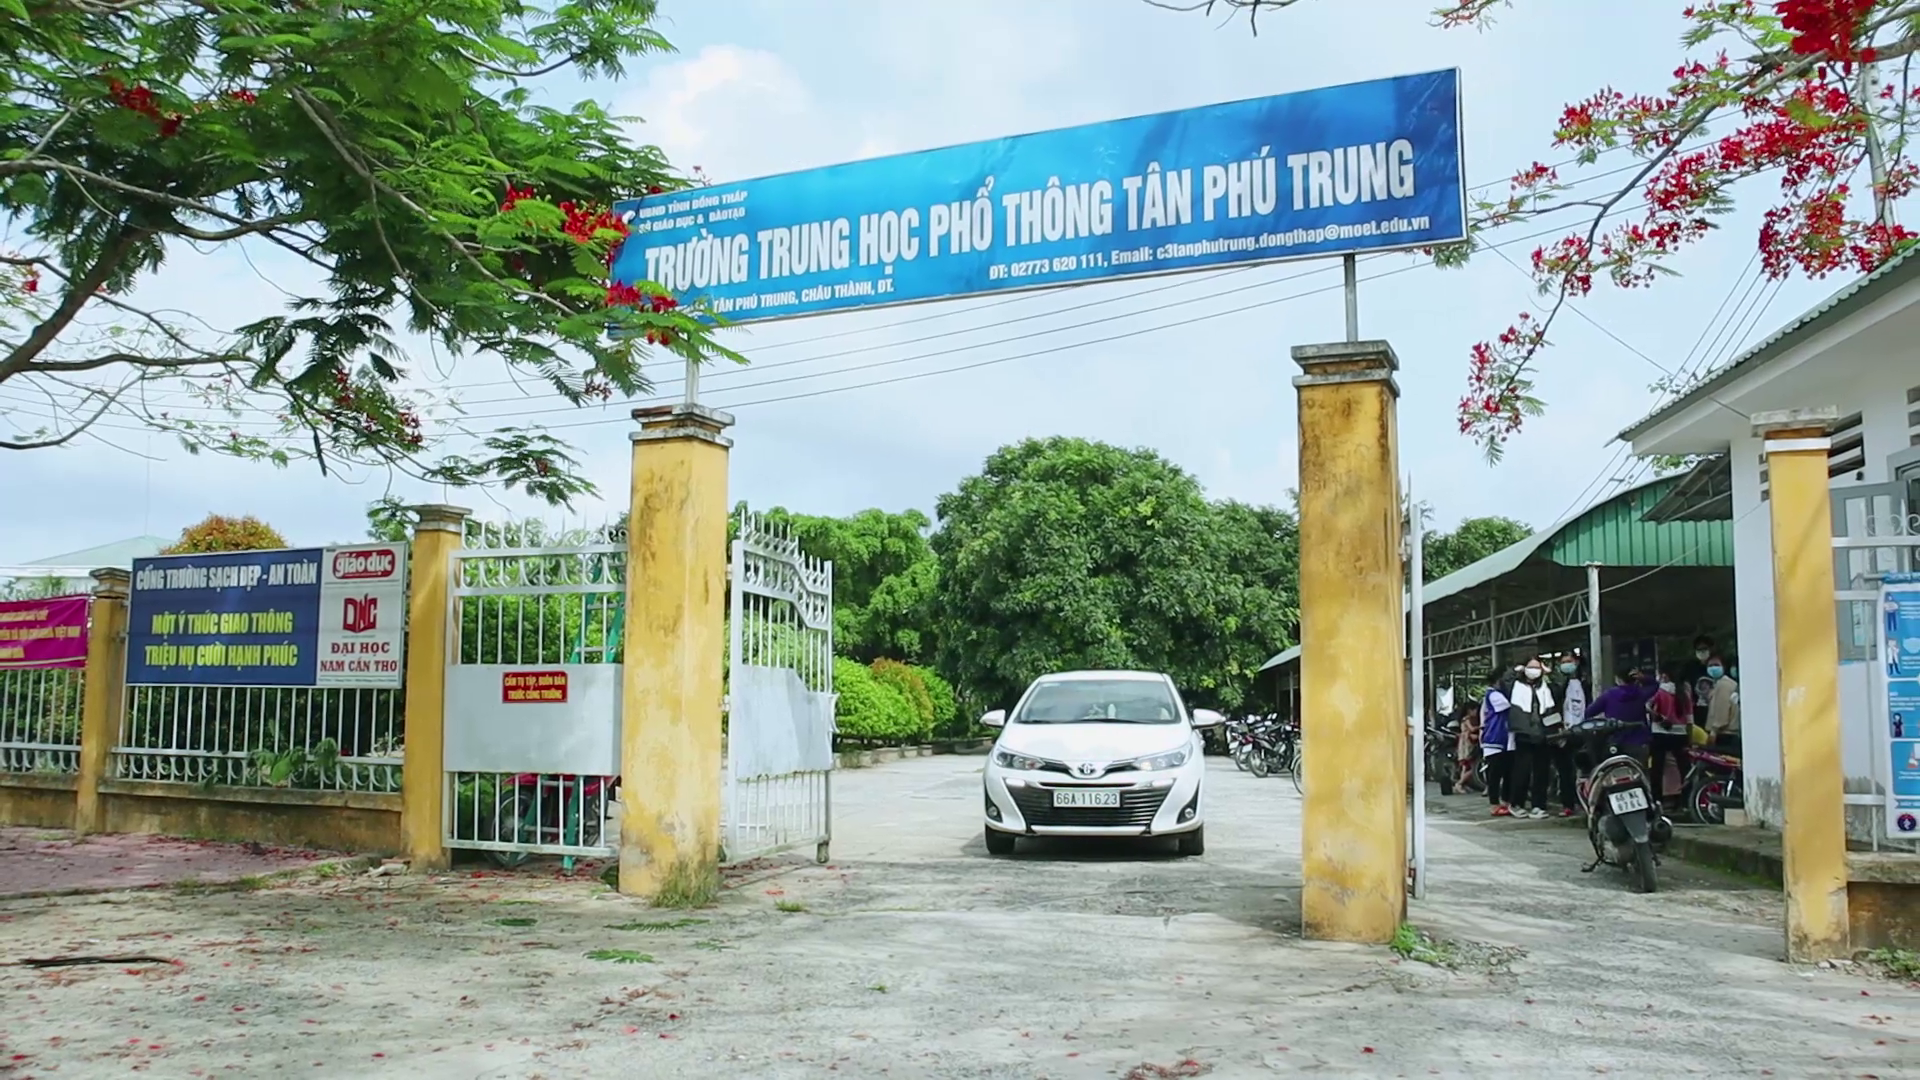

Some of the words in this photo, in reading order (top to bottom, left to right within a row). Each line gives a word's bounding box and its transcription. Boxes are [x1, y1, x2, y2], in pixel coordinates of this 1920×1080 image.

[721, 190, 748, 205] THÁP
[645, 227, 749, 293] TRƯỜNG
[757, 217, 851, 281] TRUNG
[858, 207, 920, 276] HỌC
[929, 174, 995, 258] PHỔ
[1002, 175, 1114, 247] THÔNG
[1122, 161, 1192, 232] TÂN
[1203, 145, 1277, 222] PHÚ
[1286, 138, 1415, 211] TRUNG
[652, 219, 675, 232] GIÁO
[1011, 258, 1050, 277] 02773
[1052, 256, 1077, 272] 620
[1080, 252, 1109, 269] 111,
[1111, 246, 1153, 265] Email:
[1156, 215, 1431, 260] c3tanphutrung.dongthap@moet.edu.vn
[713, 295, 734, 313] TÂN
[735, 292, 759, 311] PHÚ
[760, 292, 799, 310] TRUNG,
[801, 285, 832, 303] CHÂU
[834, 280, 875, 300] THÀNH,
[166, 564, 208, 590] TRƯỜNG
[208, 565, 239, 592] SẠCH
[268, 563, 287, 586] AN
[287, 558, 318, 585] TOÀN
[335, 552, 366, 579] giáo
[366, 551, 393, 576] dục
[152, 611, 177, 639] MỘT
[188, 609, 219, 635] THÚC
[220, 612, 249, 634] GIAO
[251, 608, 293, 634] THÔNG
[145, 642, 177, 671] TRIỆU
[178, 644, 195, 671] NỤ
[197, 641, 226, 667] CƯỜI
[227, 645, 261, 671] HẠNH
[263, 640, 299, 667] PHÚC
[331, 642, 356, 657] ĐẠI
[360, 642, 390, 657] HỌC
[320, 661, 345, 672] NAM
